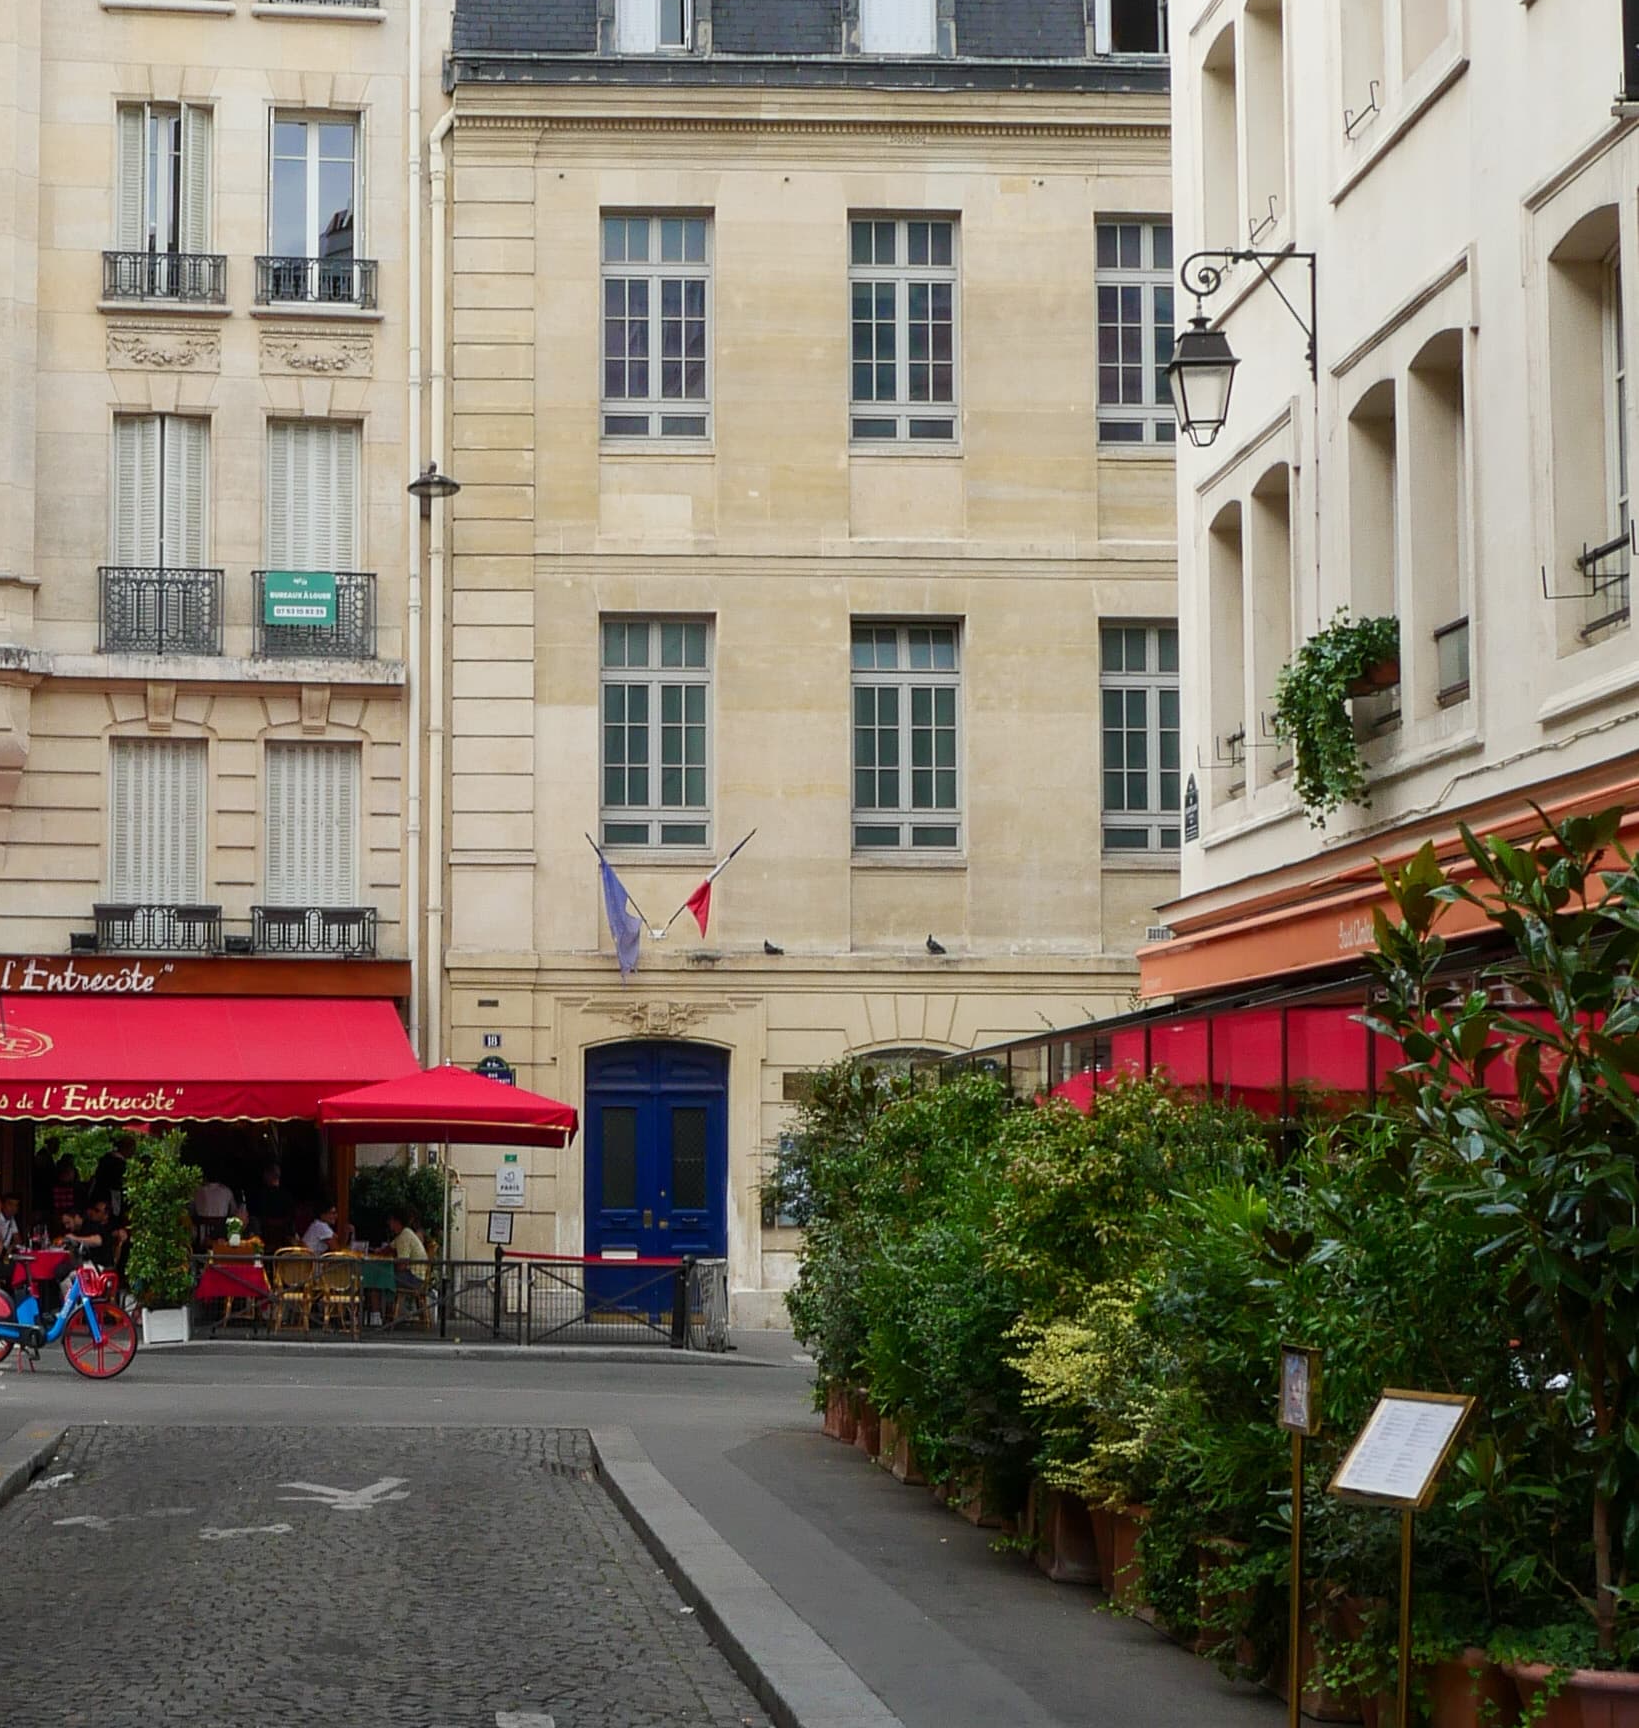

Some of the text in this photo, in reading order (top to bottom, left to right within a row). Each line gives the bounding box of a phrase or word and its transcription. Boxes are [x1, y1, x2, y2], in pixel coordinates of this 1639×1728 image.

[270, 591, 302, 599] BUREAUX
[309, 591, 331, 600] LOUER
[487, 1035, 498, 1047] 18
[16, 1092, 34, 1110] de
[500, 1183, 520, 1192] PARIS
